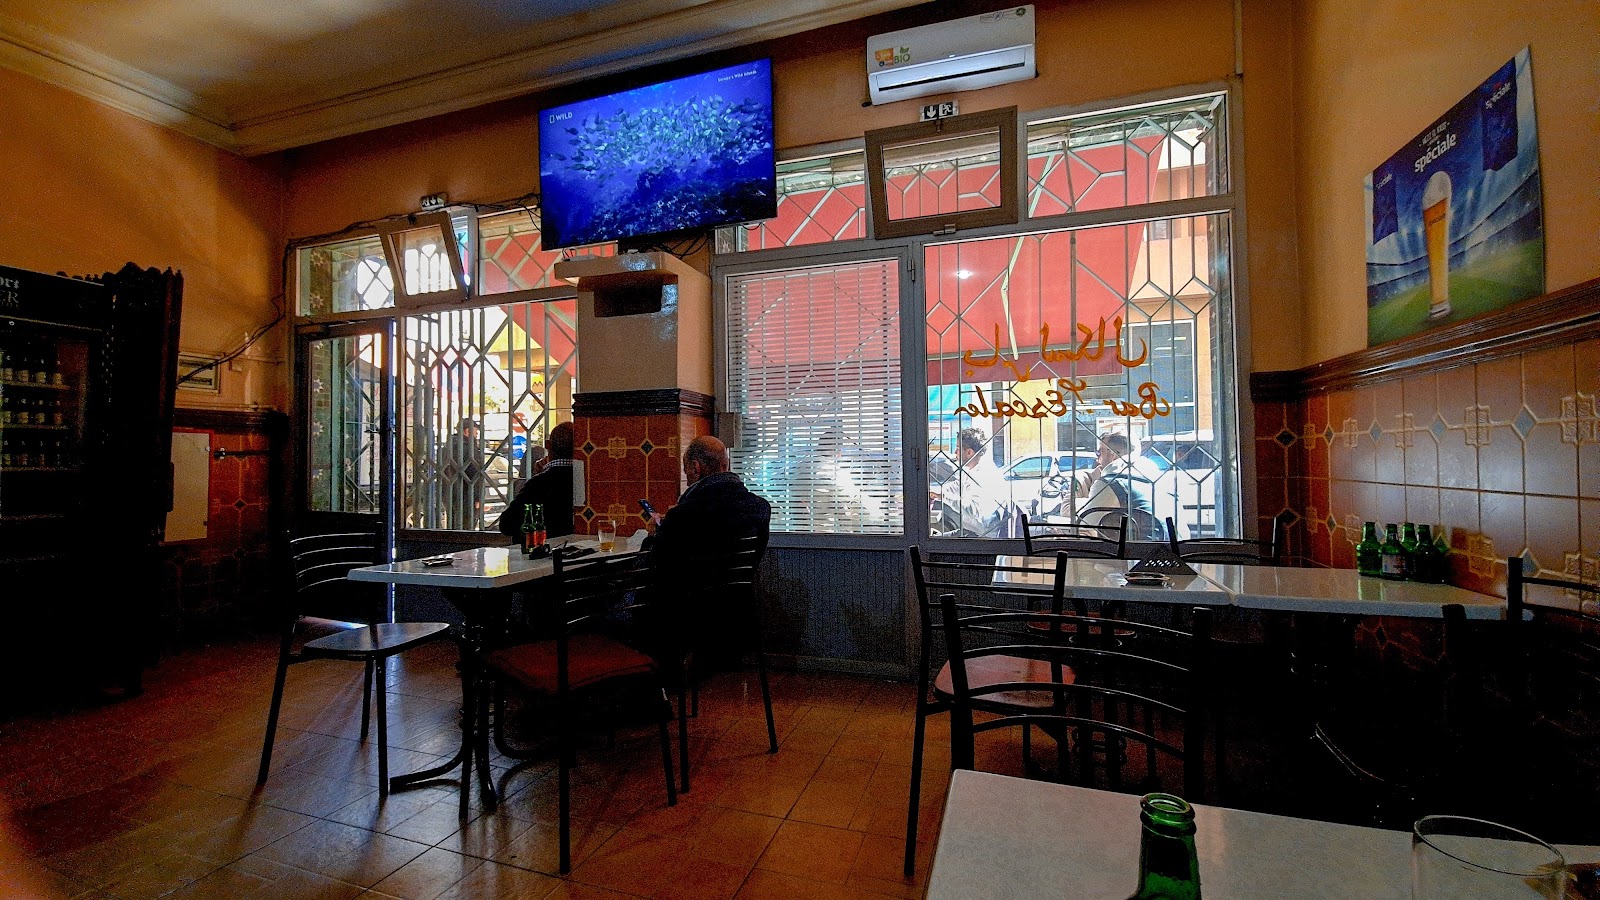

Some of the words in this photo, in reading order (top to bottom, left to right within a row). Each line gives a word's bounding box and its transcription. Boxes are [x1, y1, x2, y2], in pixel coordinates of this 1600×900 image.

[894, 53, 910, 63] BIO
[555, 112, 573, 120] WILD
[1414, 133, 1457, 173] spéciale
